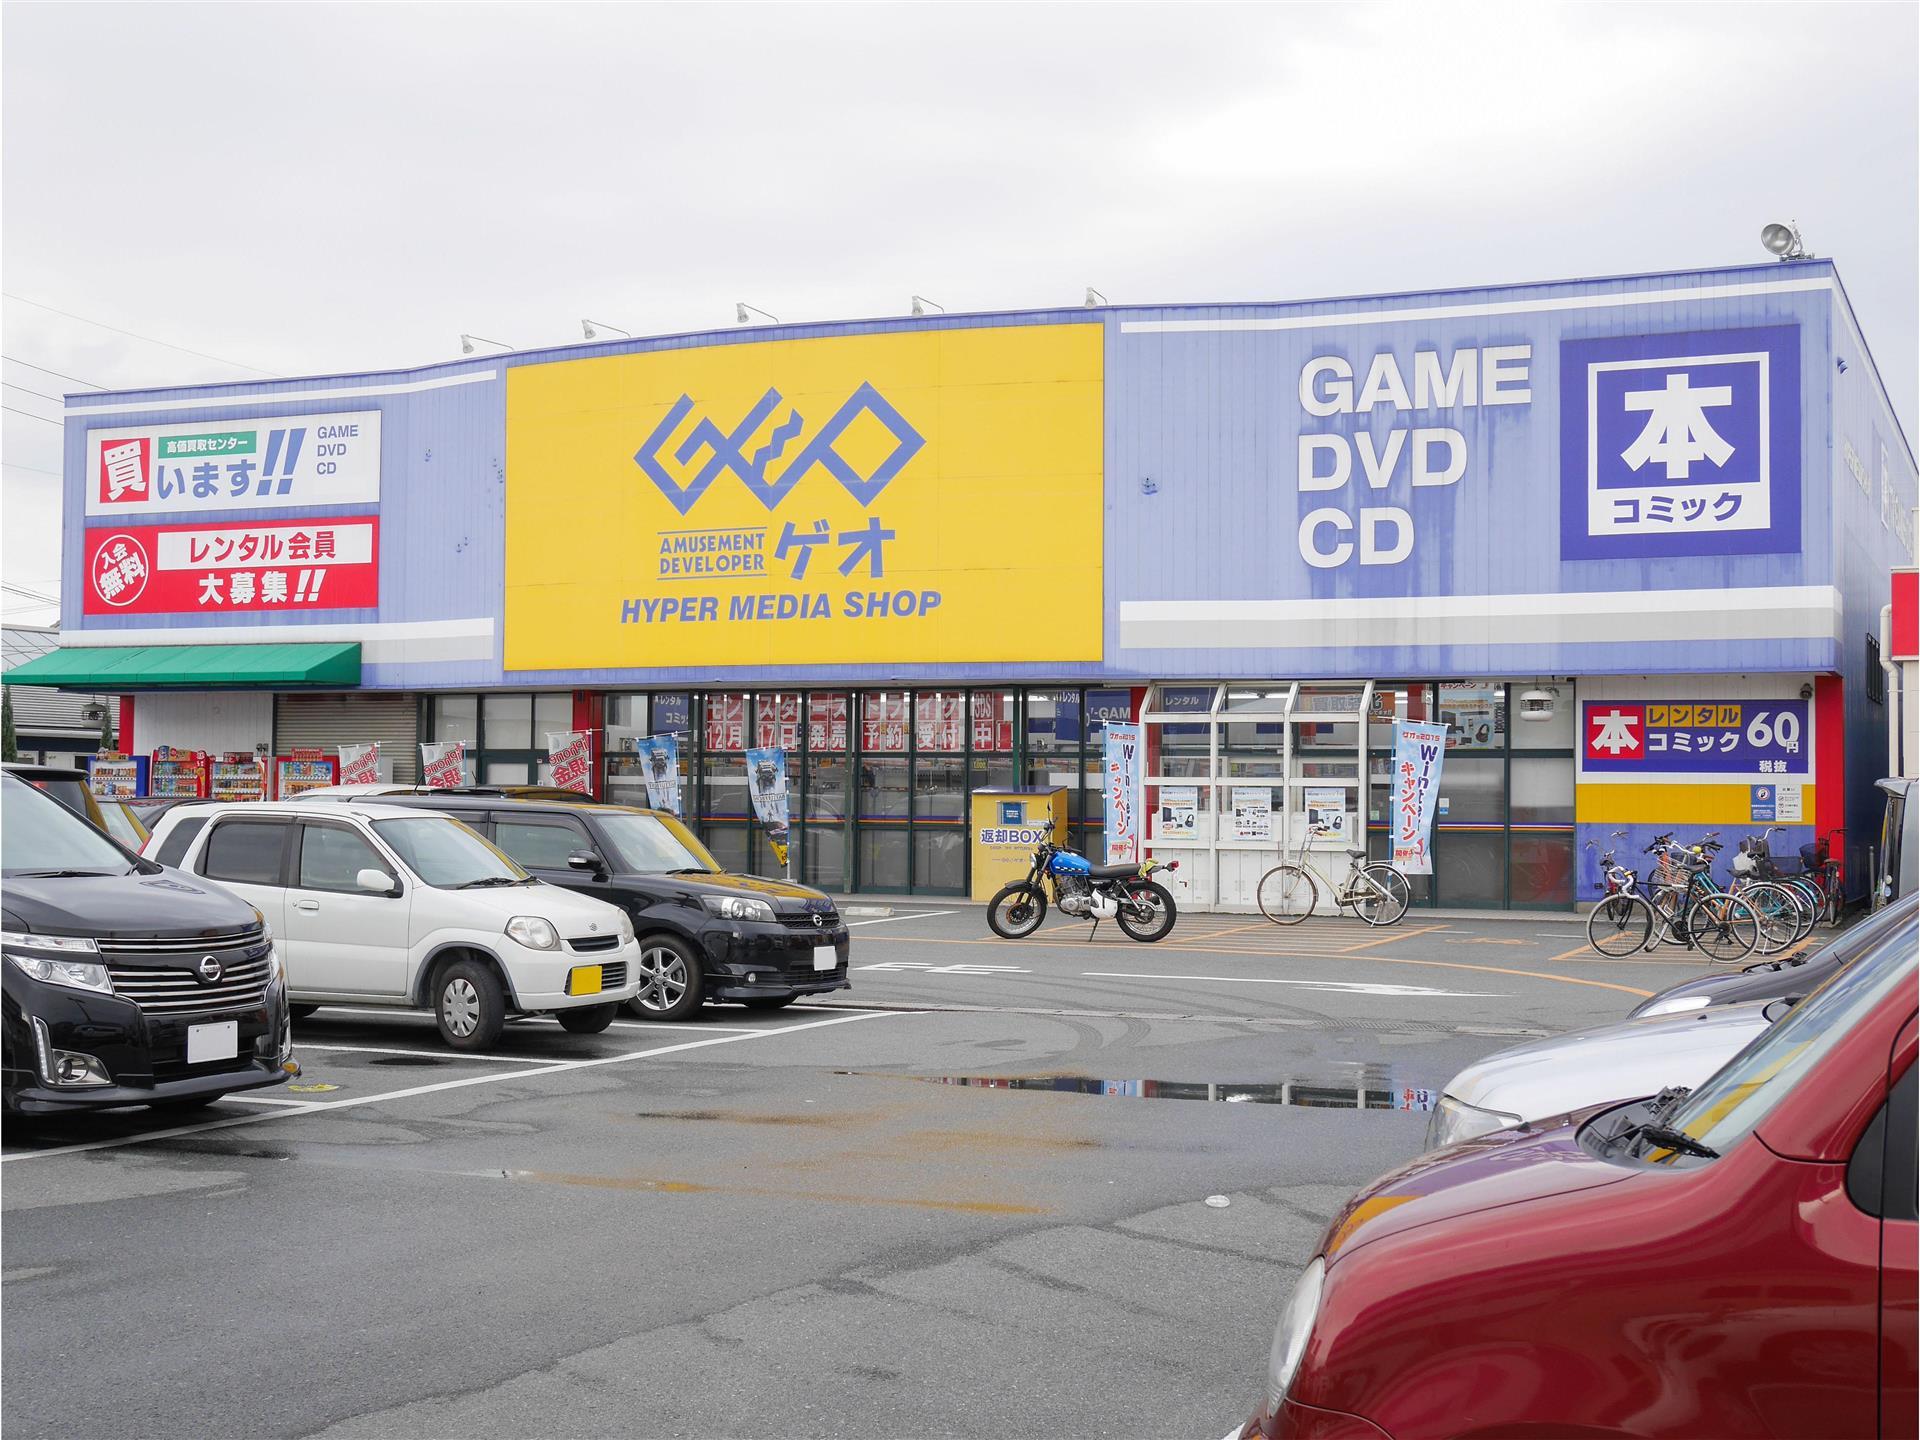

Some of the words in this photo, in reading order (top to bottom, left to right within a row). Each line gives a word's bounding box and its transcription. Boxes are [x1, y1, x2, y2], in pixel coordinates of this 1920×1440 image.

[1299, 344, 1531, 417] GAME
[317, 424, 359, 439] GAME
[1620, 372, 1736, 479] 本
[166, 436, 248, 455] 高価買取センター
[316, 442, 347, 457] DVD
[633, 380, 926, 516] GEO
[1298, 428, 1468, 491] DVD
[316, 461, 337, 475] CD
[1613, 492, 1744, 525] コミック
[189, 531, 337, 563] レンタル会員
[659, 532, 765, 554] AMUSEMENT
[774, 516, 895, 581] ゲオ
[1298, 507, 1415, 568] CD
[101, 542, 129, 571] 入会
[659, 553, 765, 574] DEVELOPER
[98, 550, 145, 601] 無料
[620, 597, 718, 624] HYPER
[728, 593, 831, 622] MEDIA
[843, 589, 942, 619] SHOP
[1165, 696, 1200, 706] レンタル
[1650, 707, 1738, 724] レンタル
[1591, 709, 1639, 755] 本
[1648, 731, 1740, 753] コミック
[1759, 760, 1787, 773] 税抜
[1111, 762, 1126, 836] キャンペーン
[1401, 761, 1417, 841] キャンペーン
[981, 829, 1043, 843] 返却BOX
